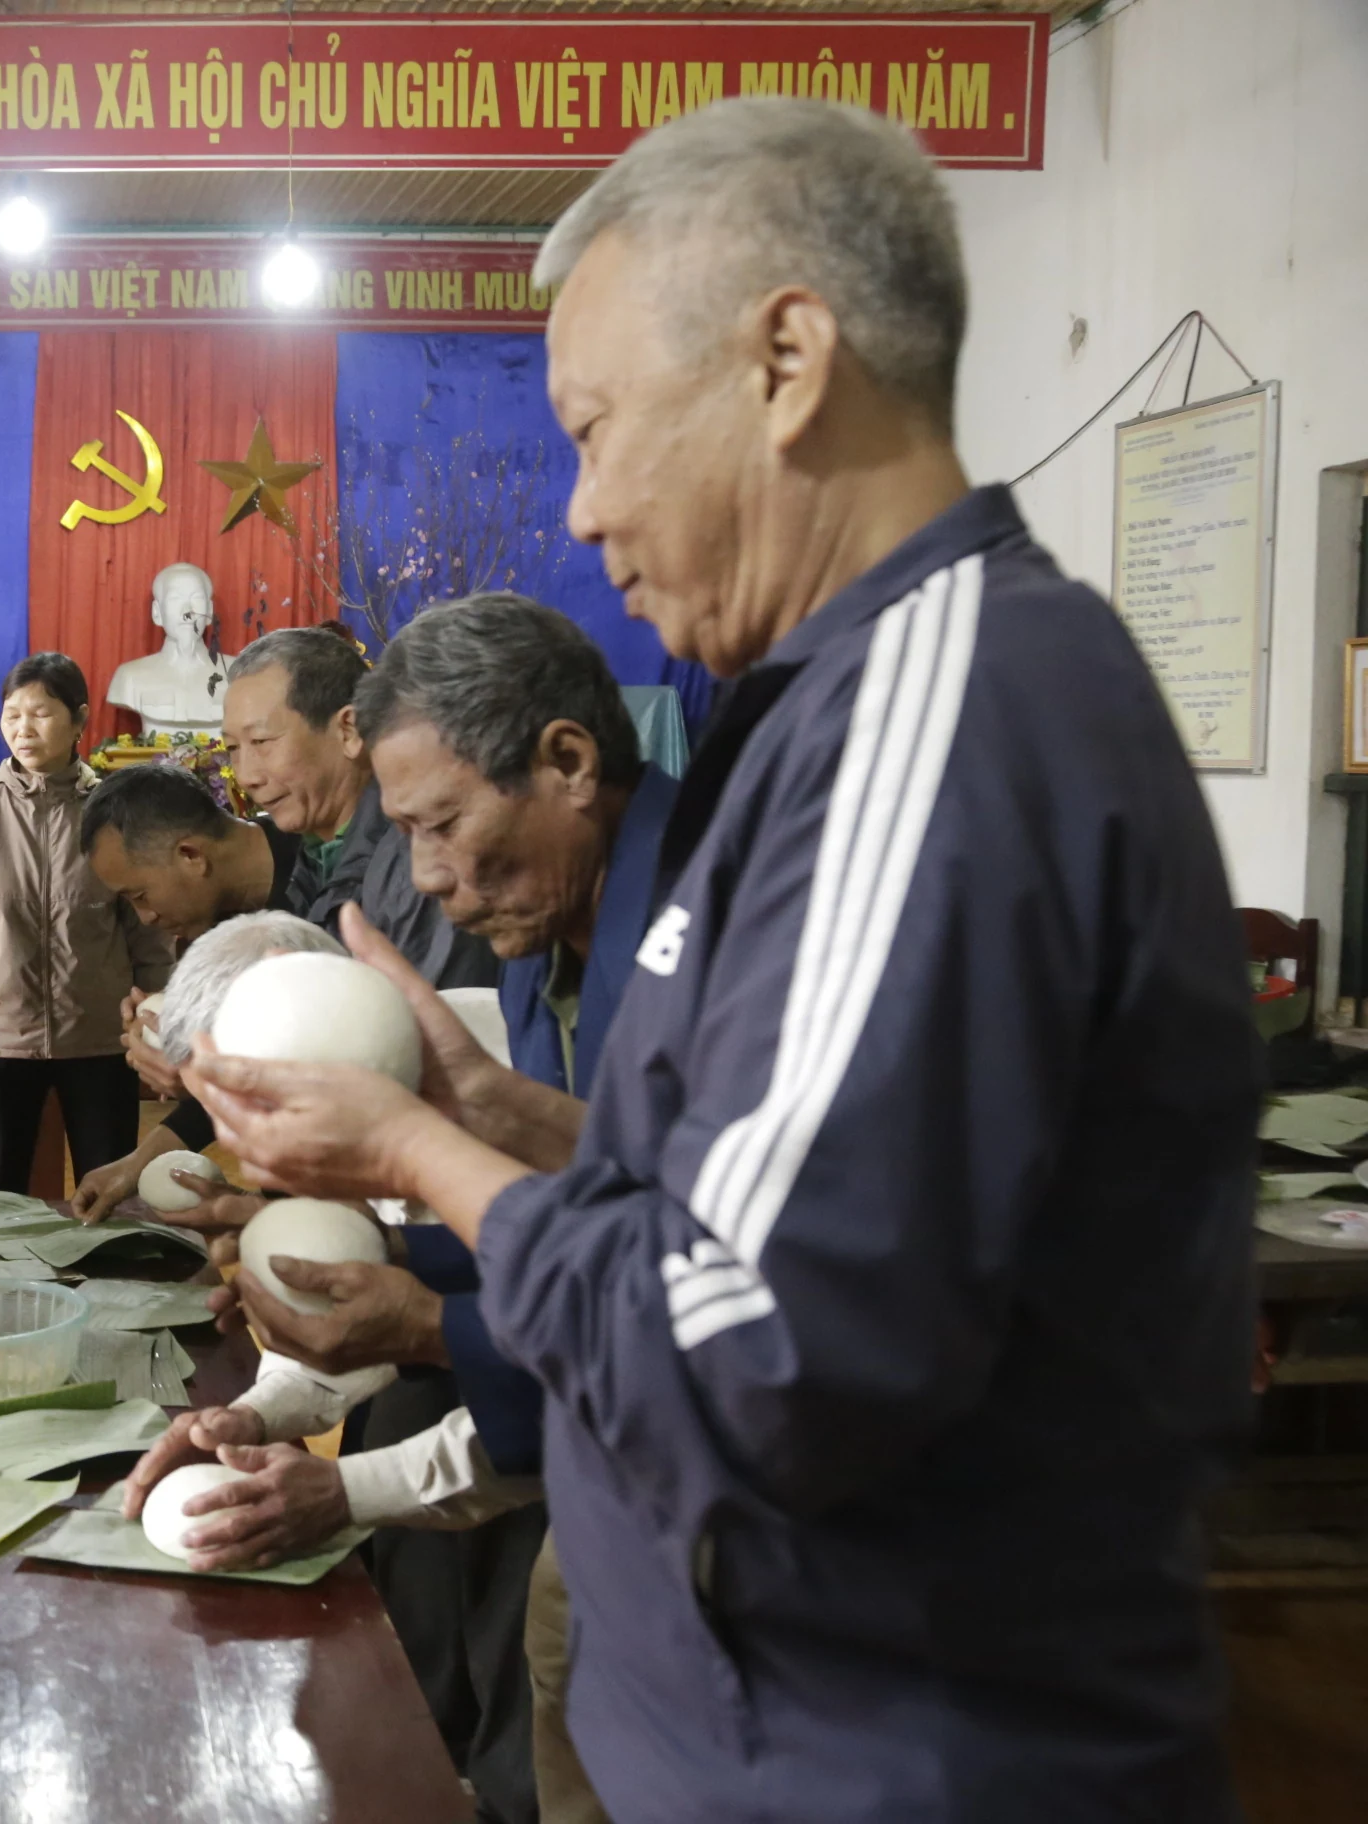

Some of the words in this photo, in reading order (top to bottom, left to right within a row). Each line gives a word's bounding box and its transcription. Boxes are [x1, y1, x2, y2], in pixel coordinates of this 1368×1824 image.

[94, 49, 155, 129] XÃ
[169, 48, 243, 144] HỘI
[259, 32, 347, 129] CHỦ
[363, 48, 501, 129] NGHĨA
[515, 47, 607, 144] VIỆT
[621, 61, 724, 128] NAM
[887, 47, 990, 129] NĂM
[89, 261, 160, 318] VIỆT
[171, 269, 248, 309] NAM
[384, 271, 463, 310] VINH
